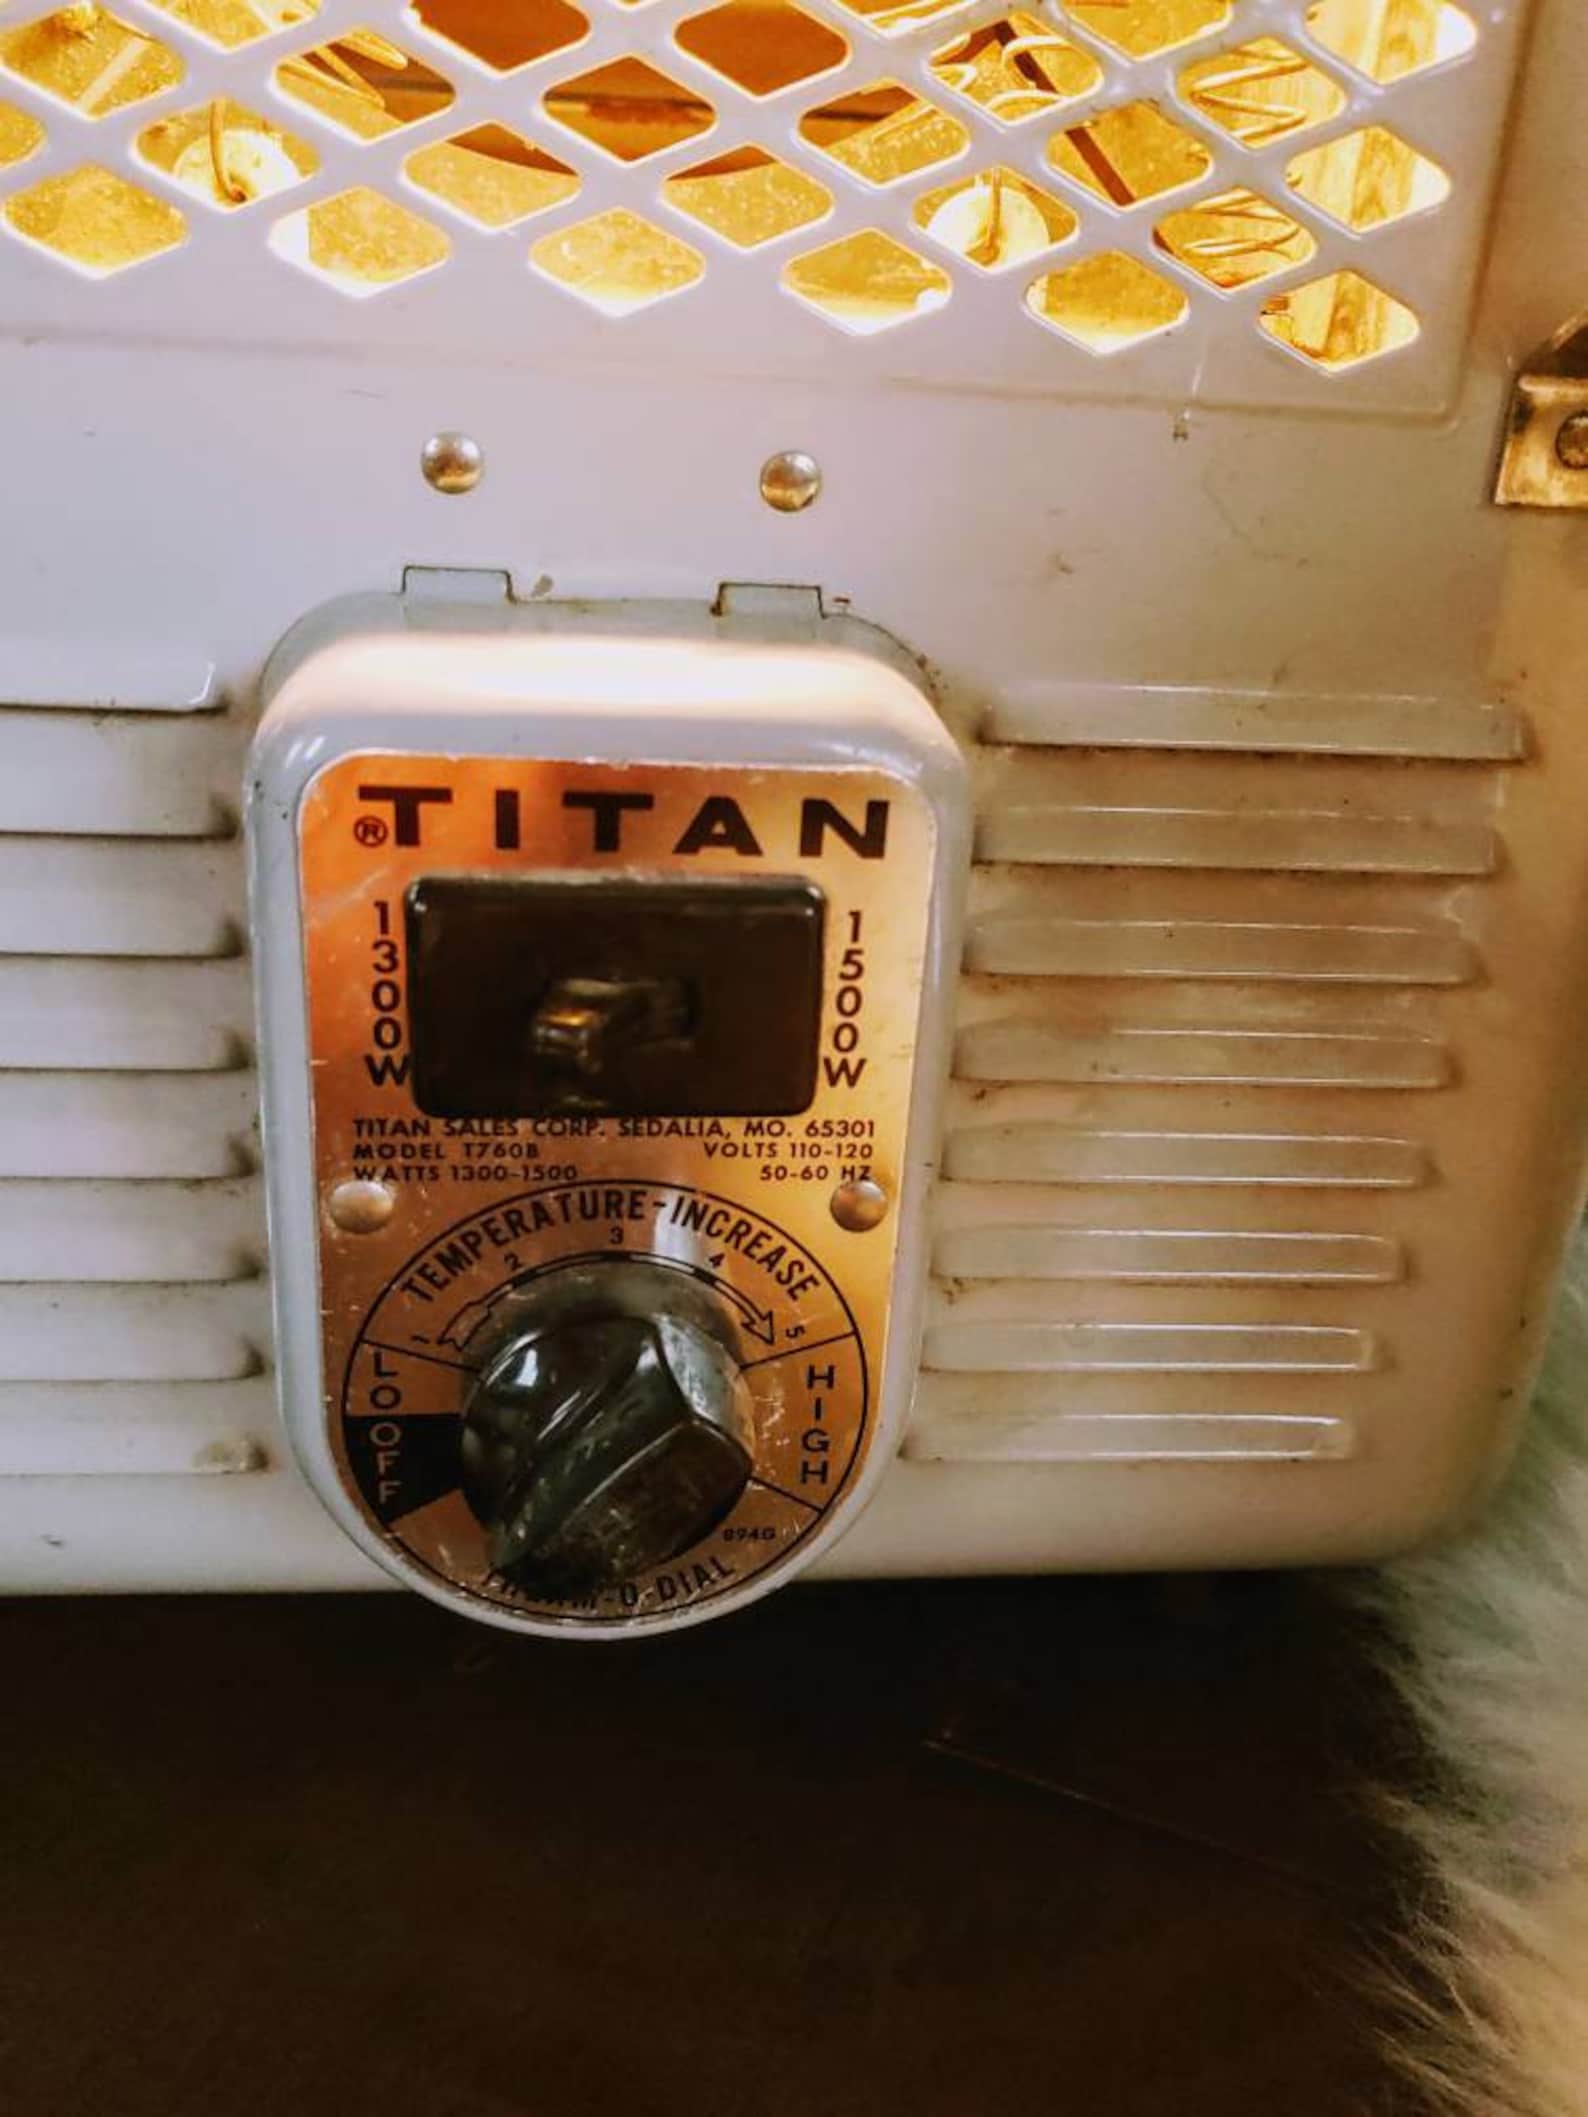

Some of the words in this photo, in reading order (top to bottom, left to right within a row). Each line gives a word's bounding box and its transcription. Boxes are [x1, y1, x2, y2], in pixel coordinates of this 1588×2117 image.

[358, 785, 889, 859] TITAN
[364, 900, 411, 1087] 1300W
[823, 909, 868, 1089] 1500W
[353, 1118, 430, 1137] TITAN
[444, 1118, 519, 1137] SALES
[532, 1118, 605, 1137] CORP.
[618, 1118, 732, 1140] SEDALIA,
[743, 1119, 792, 1137] MO.
[805, 1120, 875, 1137] 65301
[353, 1143, 444, 1160] MODEL
[463, 1143, 540, 1159] T760B
[703, 1142, 778, 1160] VOLTS
[789, 1143, 873, 1160] 110-120
[353, 1165, 440, 1182] WATTS
[451, 1165, 578, 1181] 1300-1500
[760, 1164, 829, 1181] 50-60
[841, 1165, 872, 1182] HZ
[610, 1226, 624, 1245] 3
[504, 1253, 522, 1271] 2
[709, 1253, 725, 1269] 4
[785, 1325, 806, 1339] 5
[801, 1364, 835, 1485] HIGH
[369, 1421, 402, 1504] OFF
